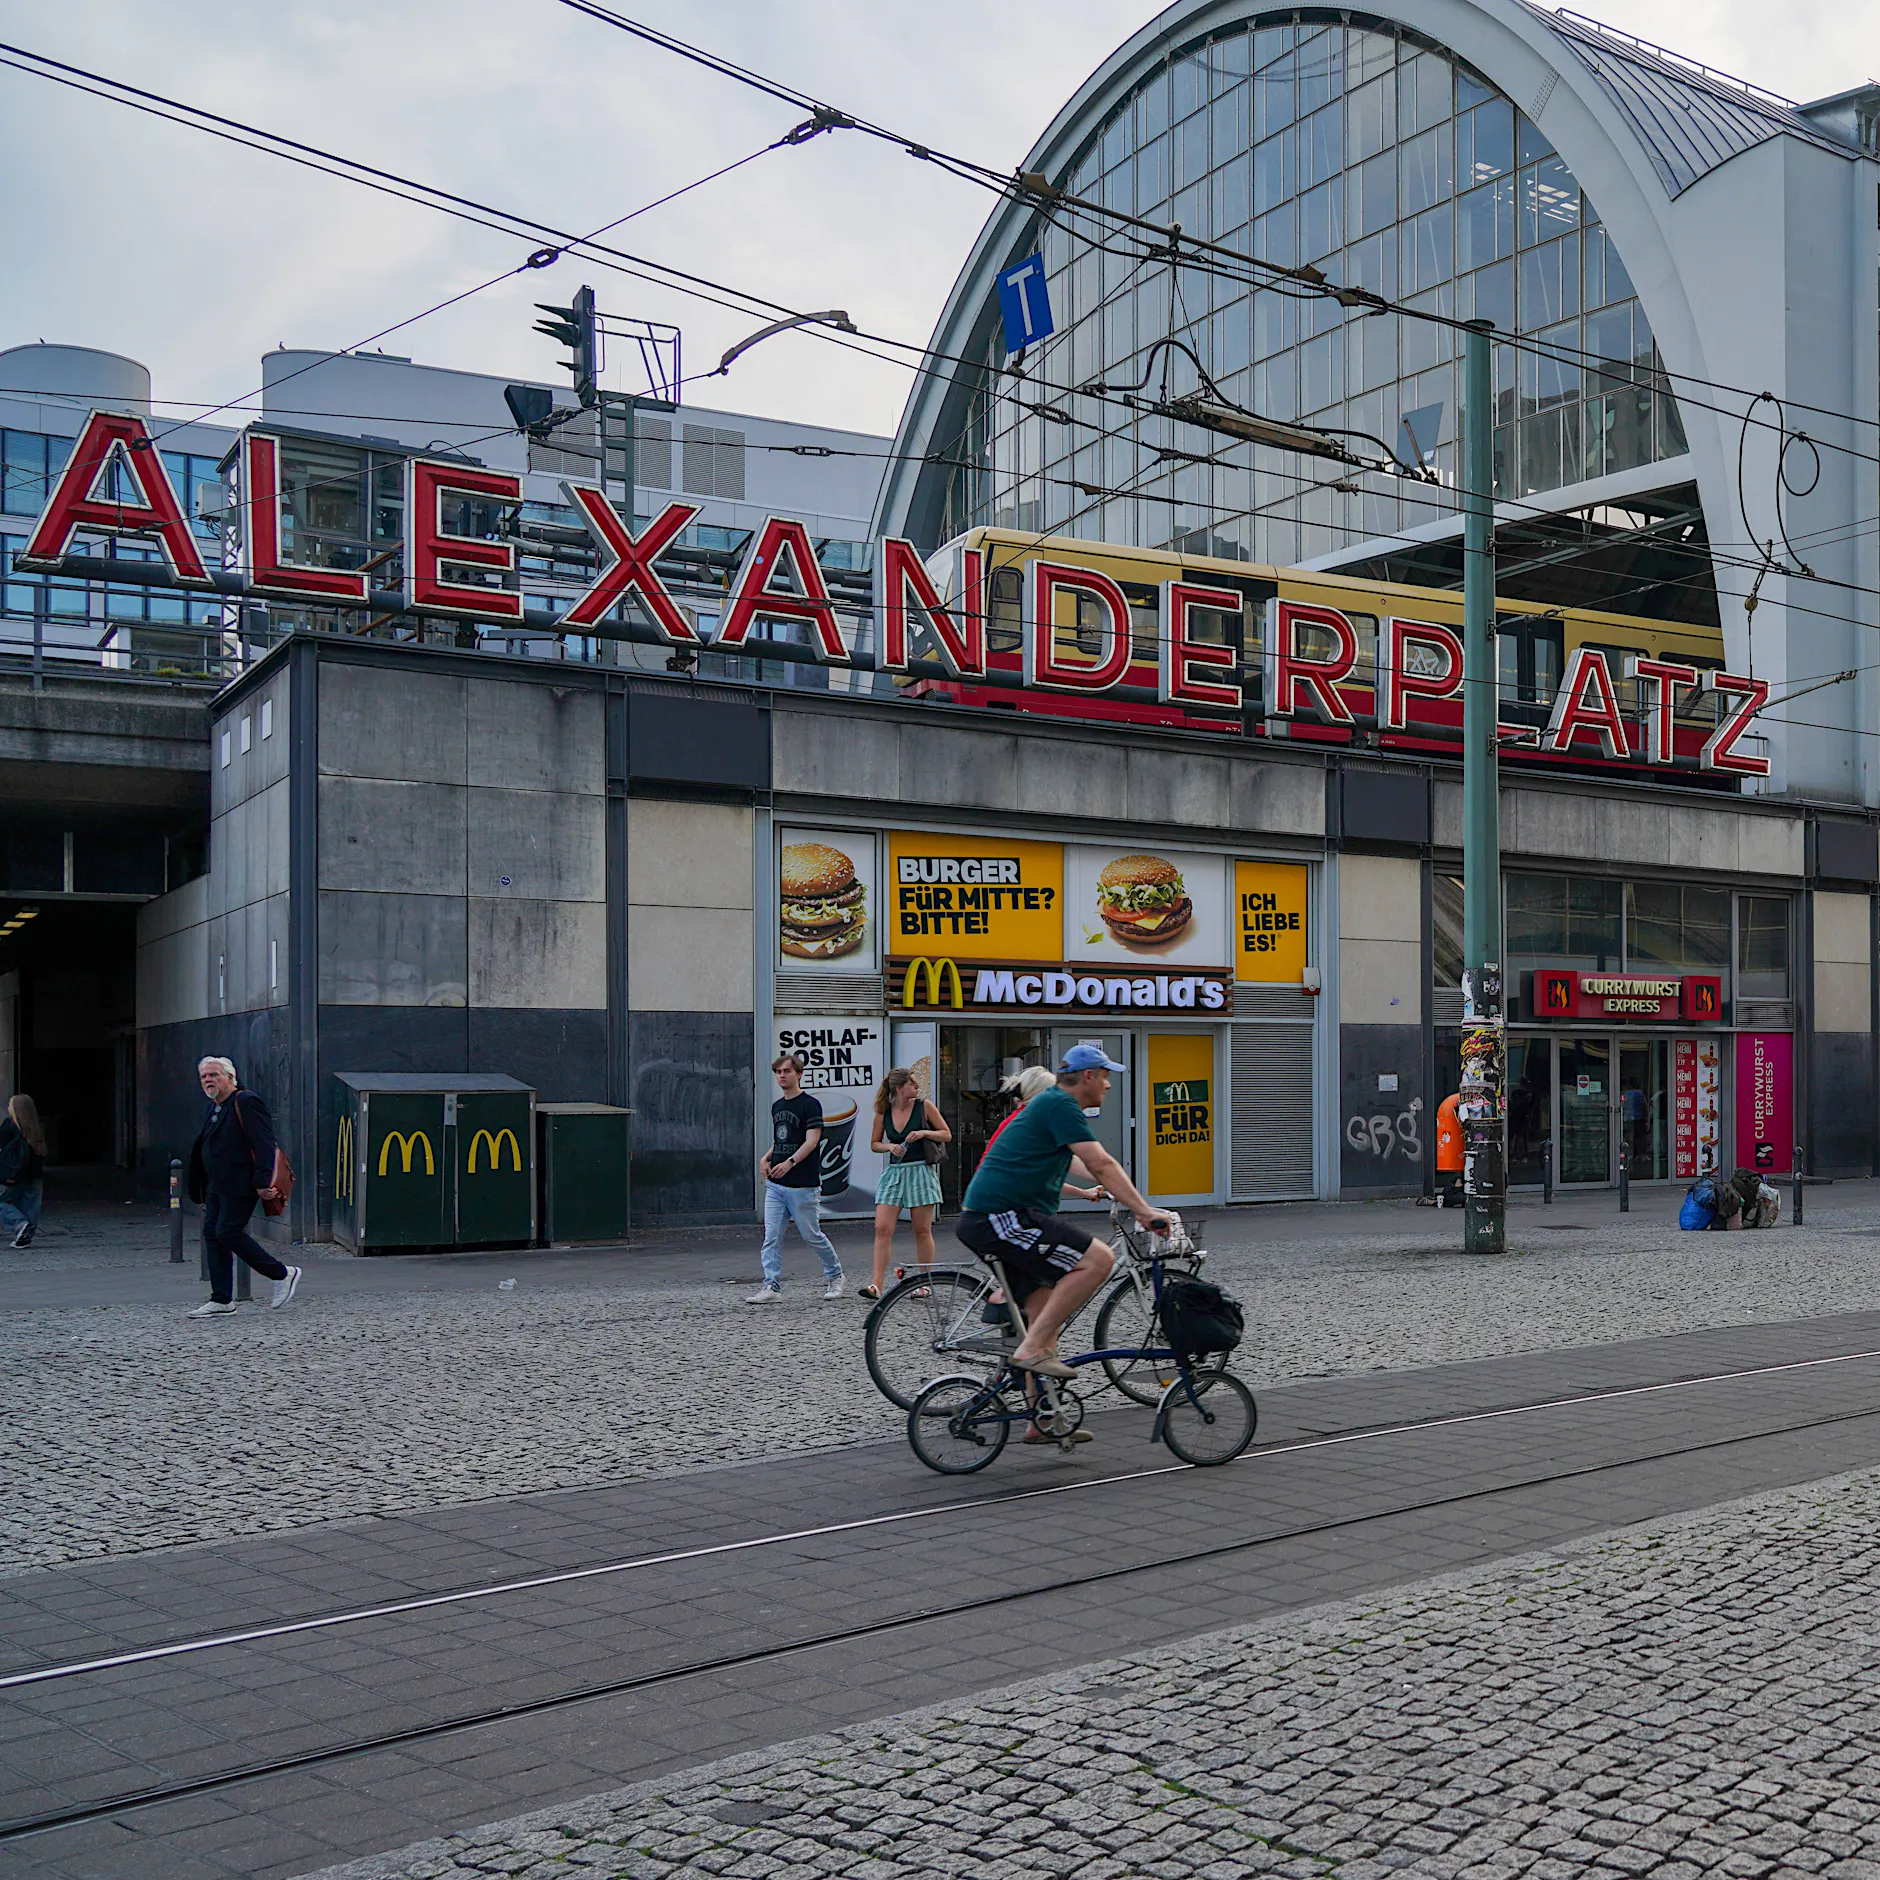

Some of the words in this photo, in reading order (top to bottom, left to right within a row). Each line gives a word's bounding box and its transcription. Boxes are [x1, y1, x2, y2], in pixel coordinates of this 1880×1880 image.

[1006, 264, 1034, 337] T
[899, 858, 1018, 883] BURGER
[958, 887, 1055, 910] MITTE?
[1242, 893, 1276, 911] ICH
[900, 912, 989, 935] BITTE!
[1243, 913, 1300, 931] LIEBE
[973, 969, 1225, 1009] McDonald's
[1581, 978, 1681, 997] CURRYWURST
[1604, 998, 1661, 1013] EXPRESS
[779, 1028, 877, 1048] SCHLAF-
[780, 1048, 825, 1067] OS
[829, 1048, 852, 1066] IN
[800, 1067, 872, 1088] ERLIN:
[1754, 1038, 1764, 1139] CURRYWURST
[1765, 1061, 1774, 1116] EXPRESS
[1156, 1133, 1187, 1146] DICH
[1189, 1130, 1210, 1143] DA!
